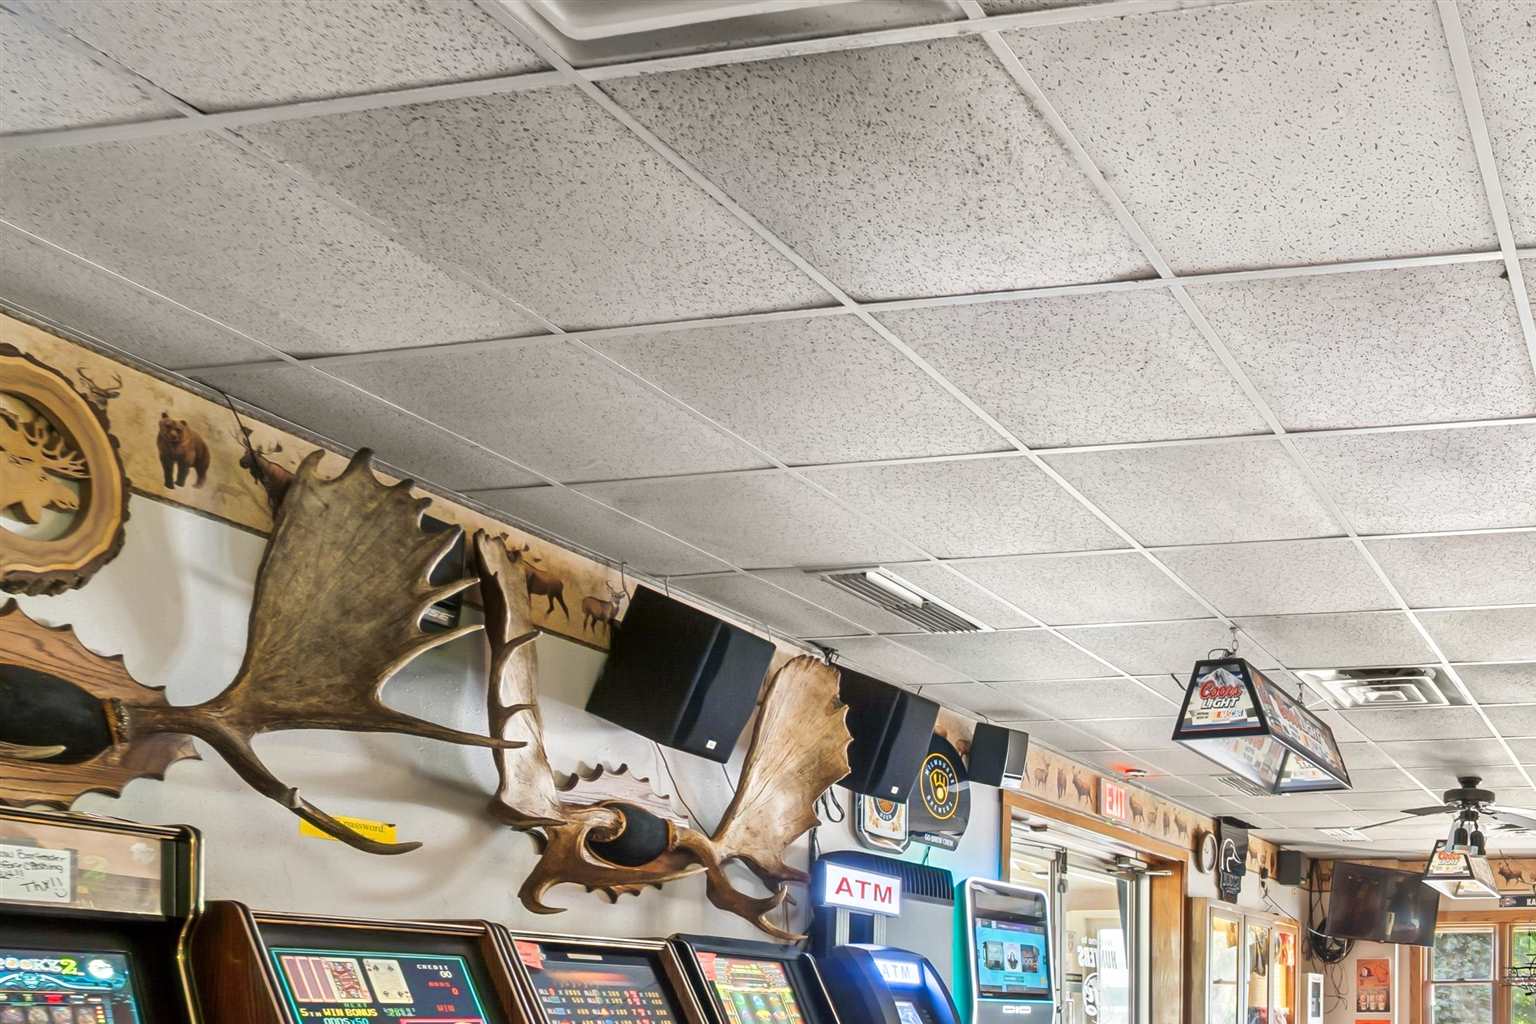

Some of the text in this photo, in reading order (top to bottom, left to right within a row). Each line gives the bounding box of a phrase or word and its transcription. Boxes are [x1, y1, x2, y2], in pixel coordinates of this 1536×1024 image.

[1201, 697, 1239, 709] LIGHT
[1105, 783, 1126, 819] EXIT
[835, 876, 893, 905] ATM
[881, 962, 913, 980] ATM
[322, 1008, 344, 1017] WIN
[345, 1008, 378, 1017] BONUS
